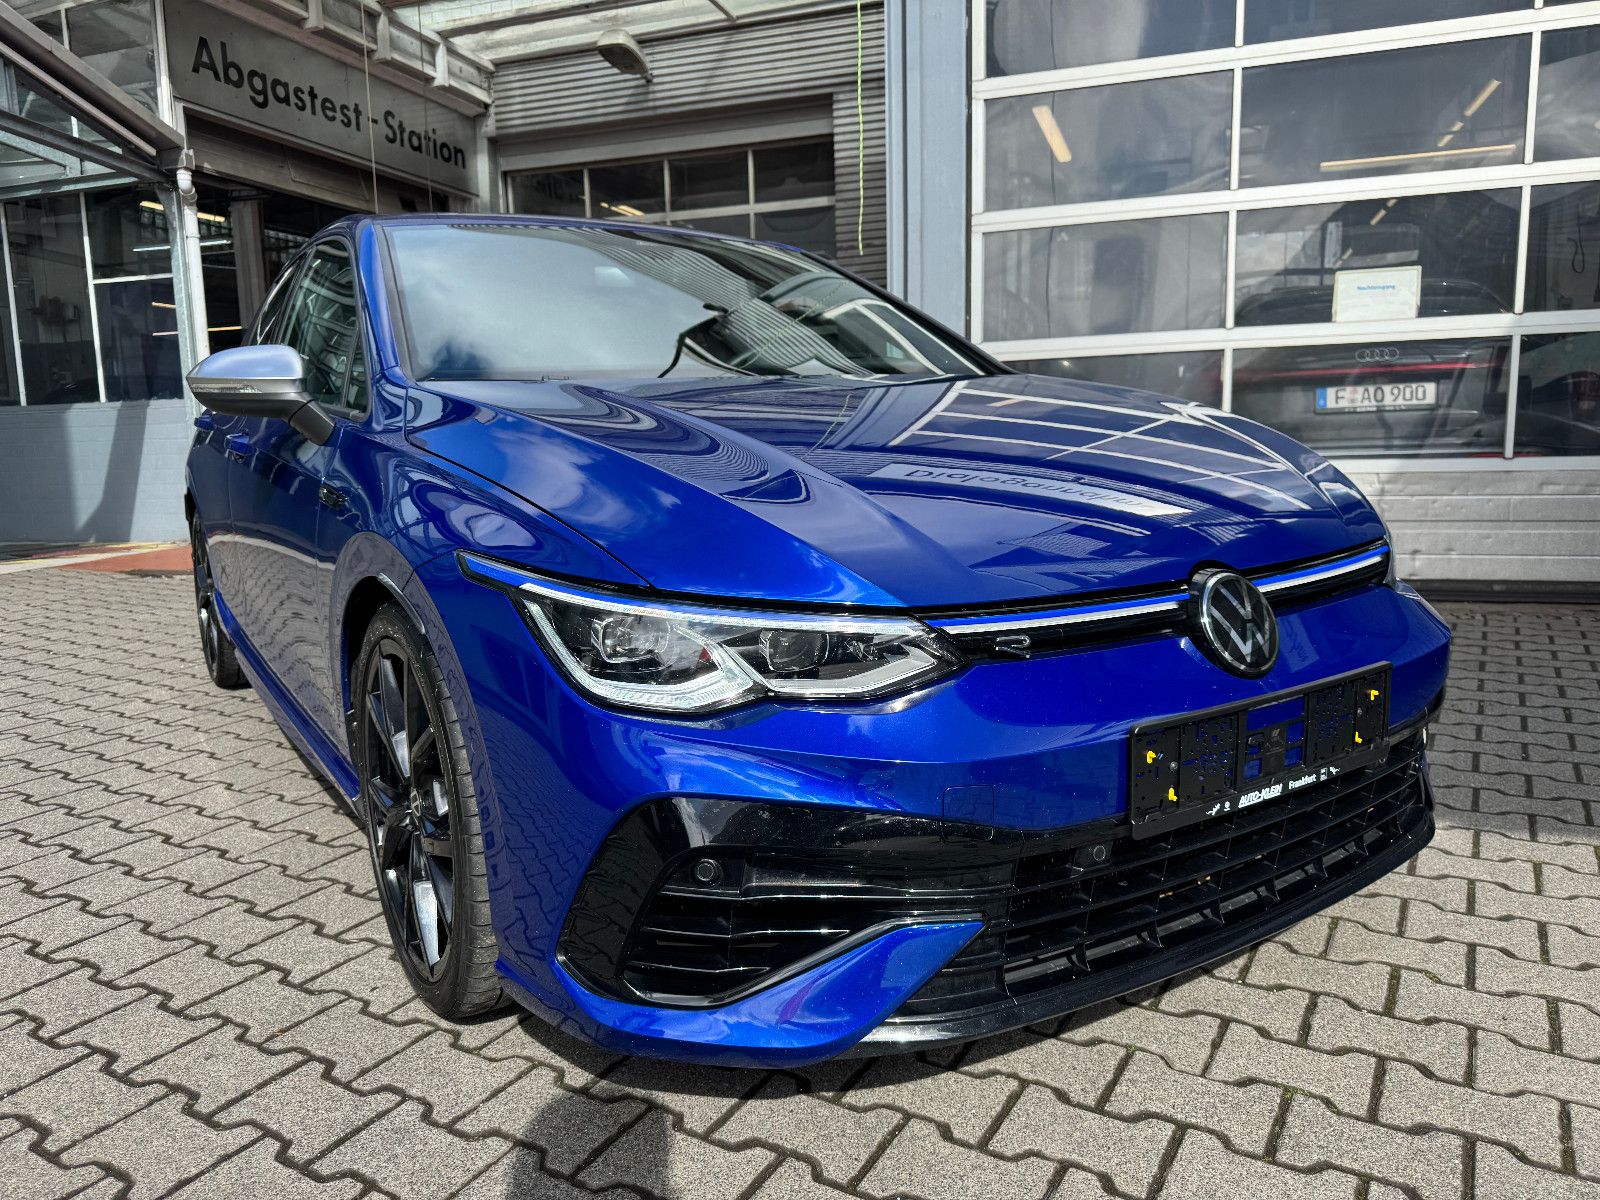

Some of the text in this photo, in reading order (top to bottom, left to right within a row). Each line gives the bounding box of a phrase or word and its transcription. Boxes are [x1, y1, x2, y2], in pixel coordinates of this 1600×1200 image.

[1335, 387, 1346, 405] F
[1390, 384, 1426, 402] 900
[1238, 783, 1283, 807] AUTO-KLEIN
[1288, 773, 1317, 790] Frankfurt
